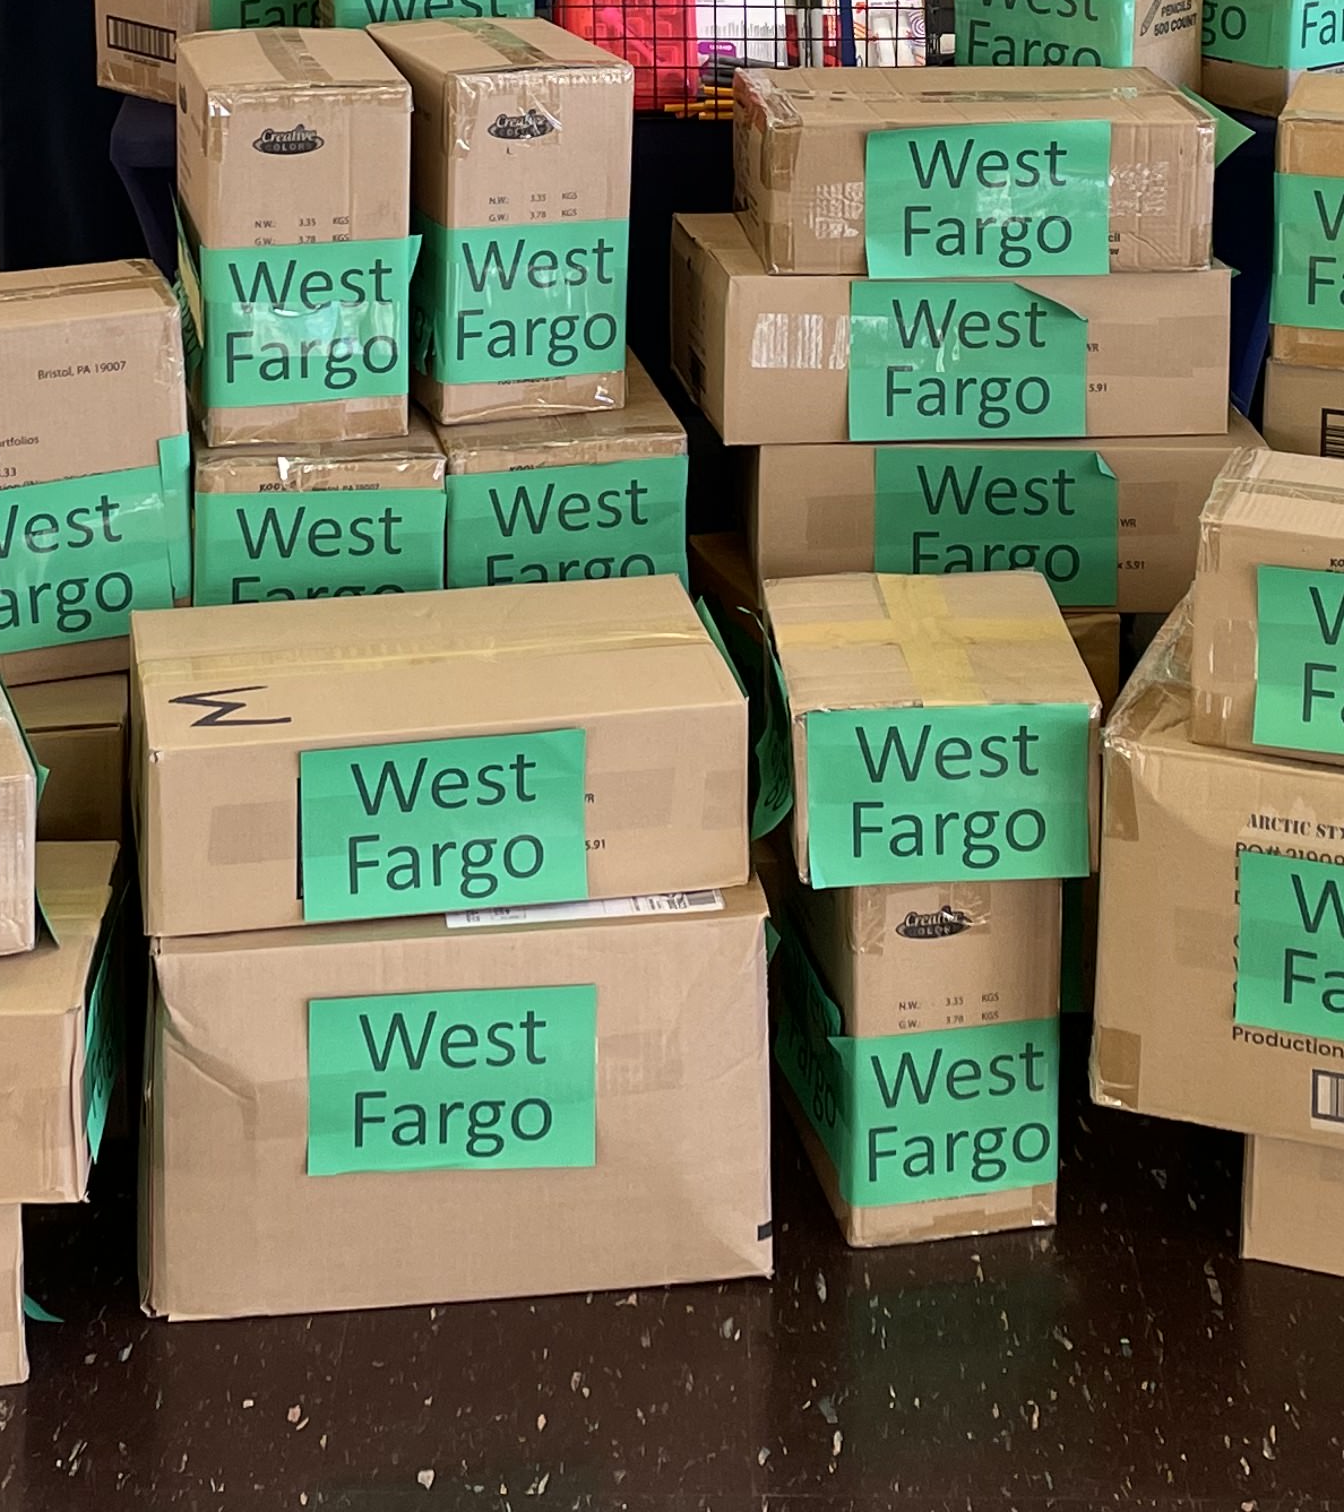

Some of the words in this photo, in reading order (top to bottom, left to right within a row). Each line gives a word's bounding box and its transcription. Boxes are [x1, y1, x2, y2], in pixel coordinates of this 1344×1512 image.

[1154, 21, 1170, 36] 500
[1171, 13, 1197, 33] COUNT
[909, 140, 1067, 189] West
[462, 238, 613, 292] West
[904, 207, 1072, 268] Fargo
[229, 258, 394, 312] West
[456, 310, 617, 367] Fargo
[892, 299, 1047, 349] West
[38, 368, 74, 380] Bristol,
[77, 365, 91, 376] PA
[95, 360, 127, 374] 19007
[226, 327, 398, 389] Fargo
[887, 367, 1051, 429] Fargo
[489, 480, 648, 537] West
[917, 466, 1075, 516] West
[237, 507, 403, 559] West
[856, 724, 1039, 783] West
[350, 752, 536, 818] West
[852, 801, 1047, 870] Fargo
[1247, 813, 1312, 836] ARCTIC
[348, 832, 546, 899] Fargo
[358, 1009, 547, 1072] West
[870, 1041, 1046, 1109] West
[353, 1090, 553, 1158] Fargo
[868, 1123, 1050, 1184] Fargo
